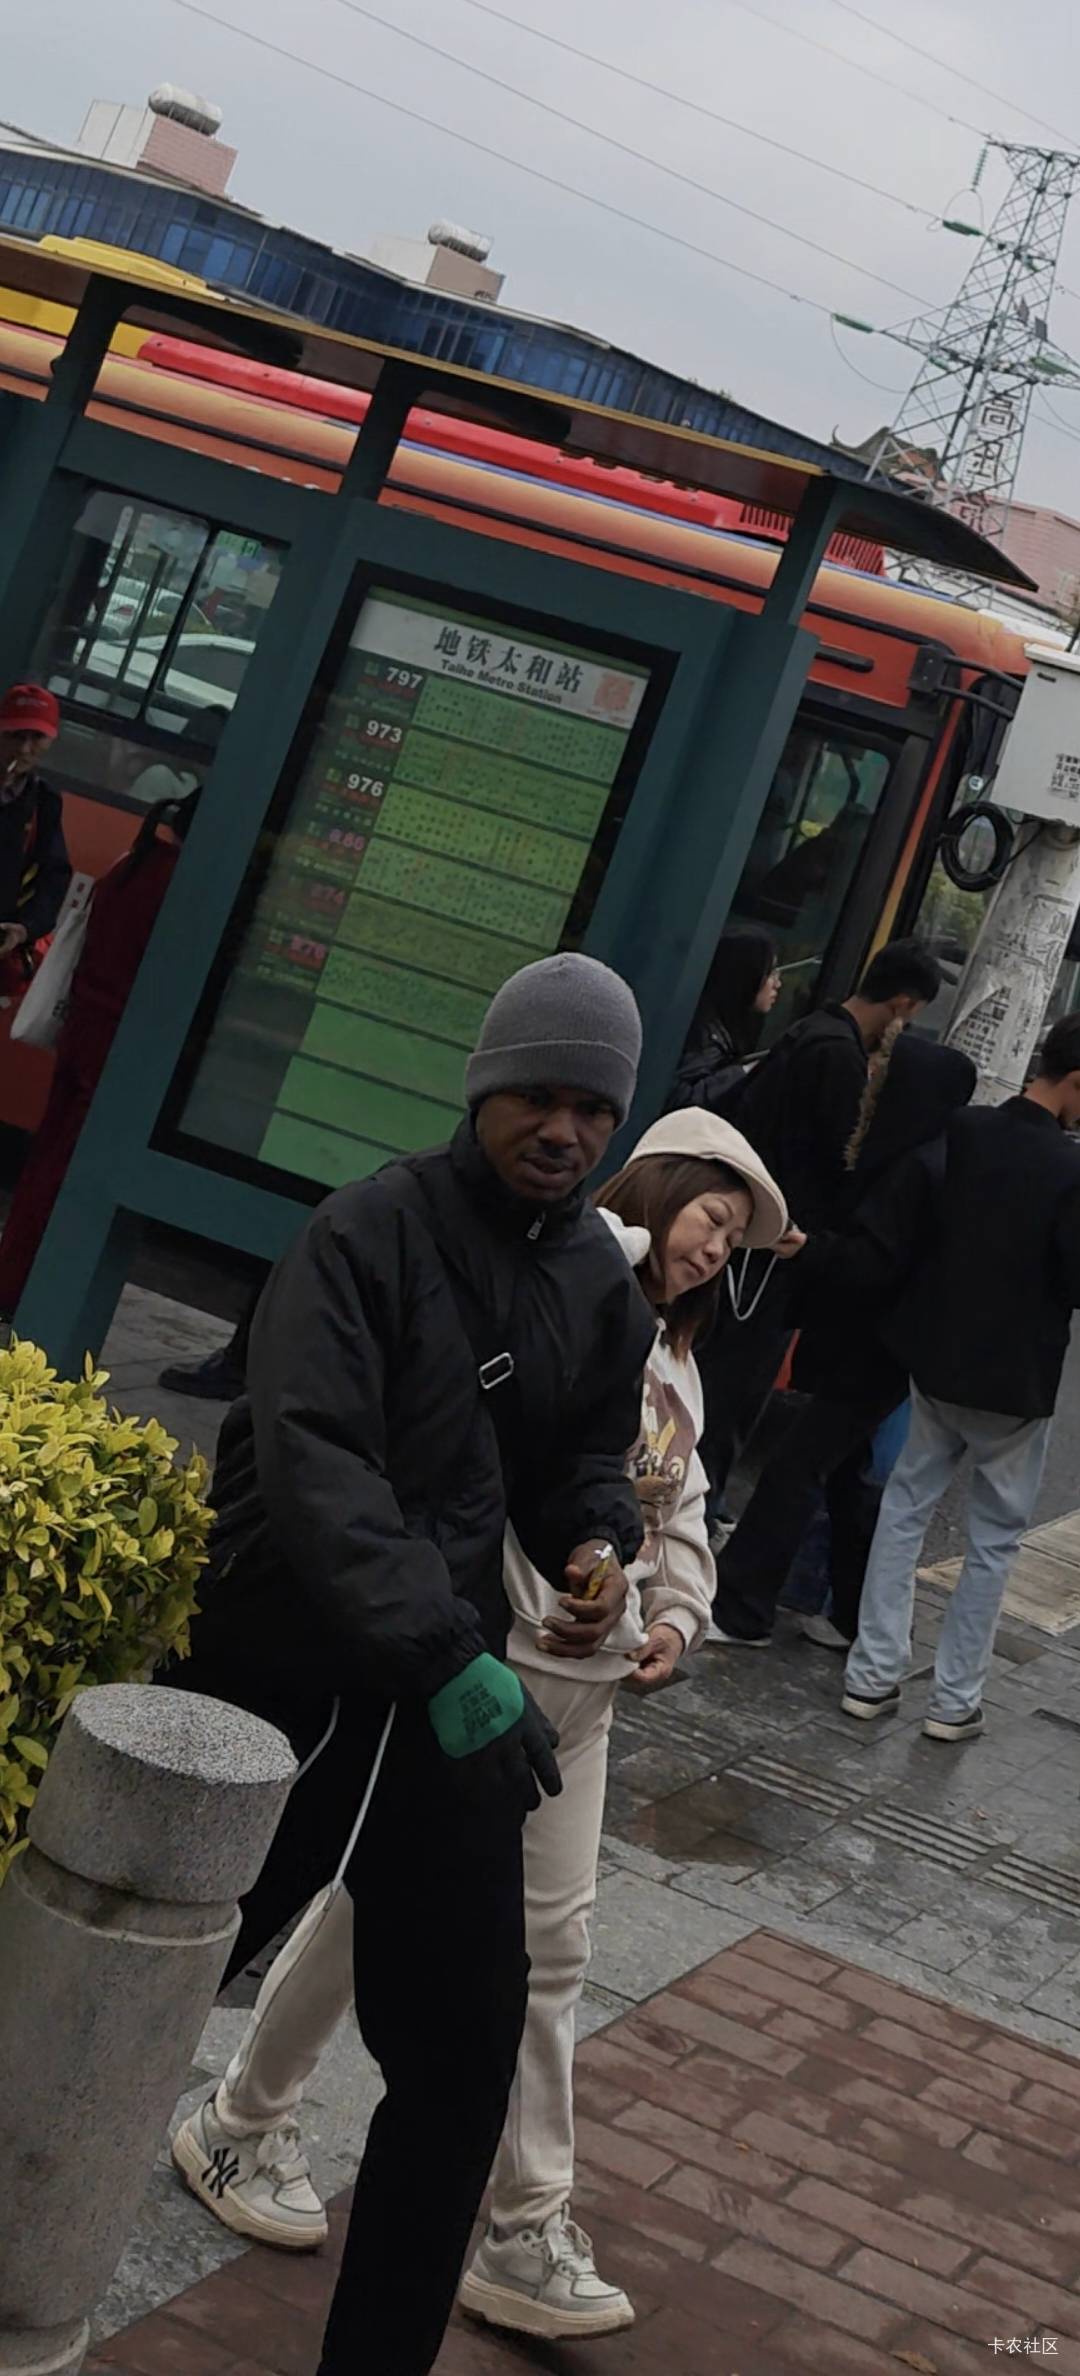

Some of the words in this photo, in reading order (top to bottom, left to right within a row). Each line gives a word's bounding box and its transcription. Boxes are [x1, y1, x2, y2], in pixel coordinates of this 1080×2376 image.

[434, 626, 583, 693] 地铁太和站
[386, 667, 423, 689] 797
[441, 659, 474, 678] Taihe
[477, 670, 514, 689] Metro
[517, 682, 562, 704] Station
[366, 720, 402, 743] 973
[347, 774, 384, 797] 976
[201, 2147, 239, 2199] NY
